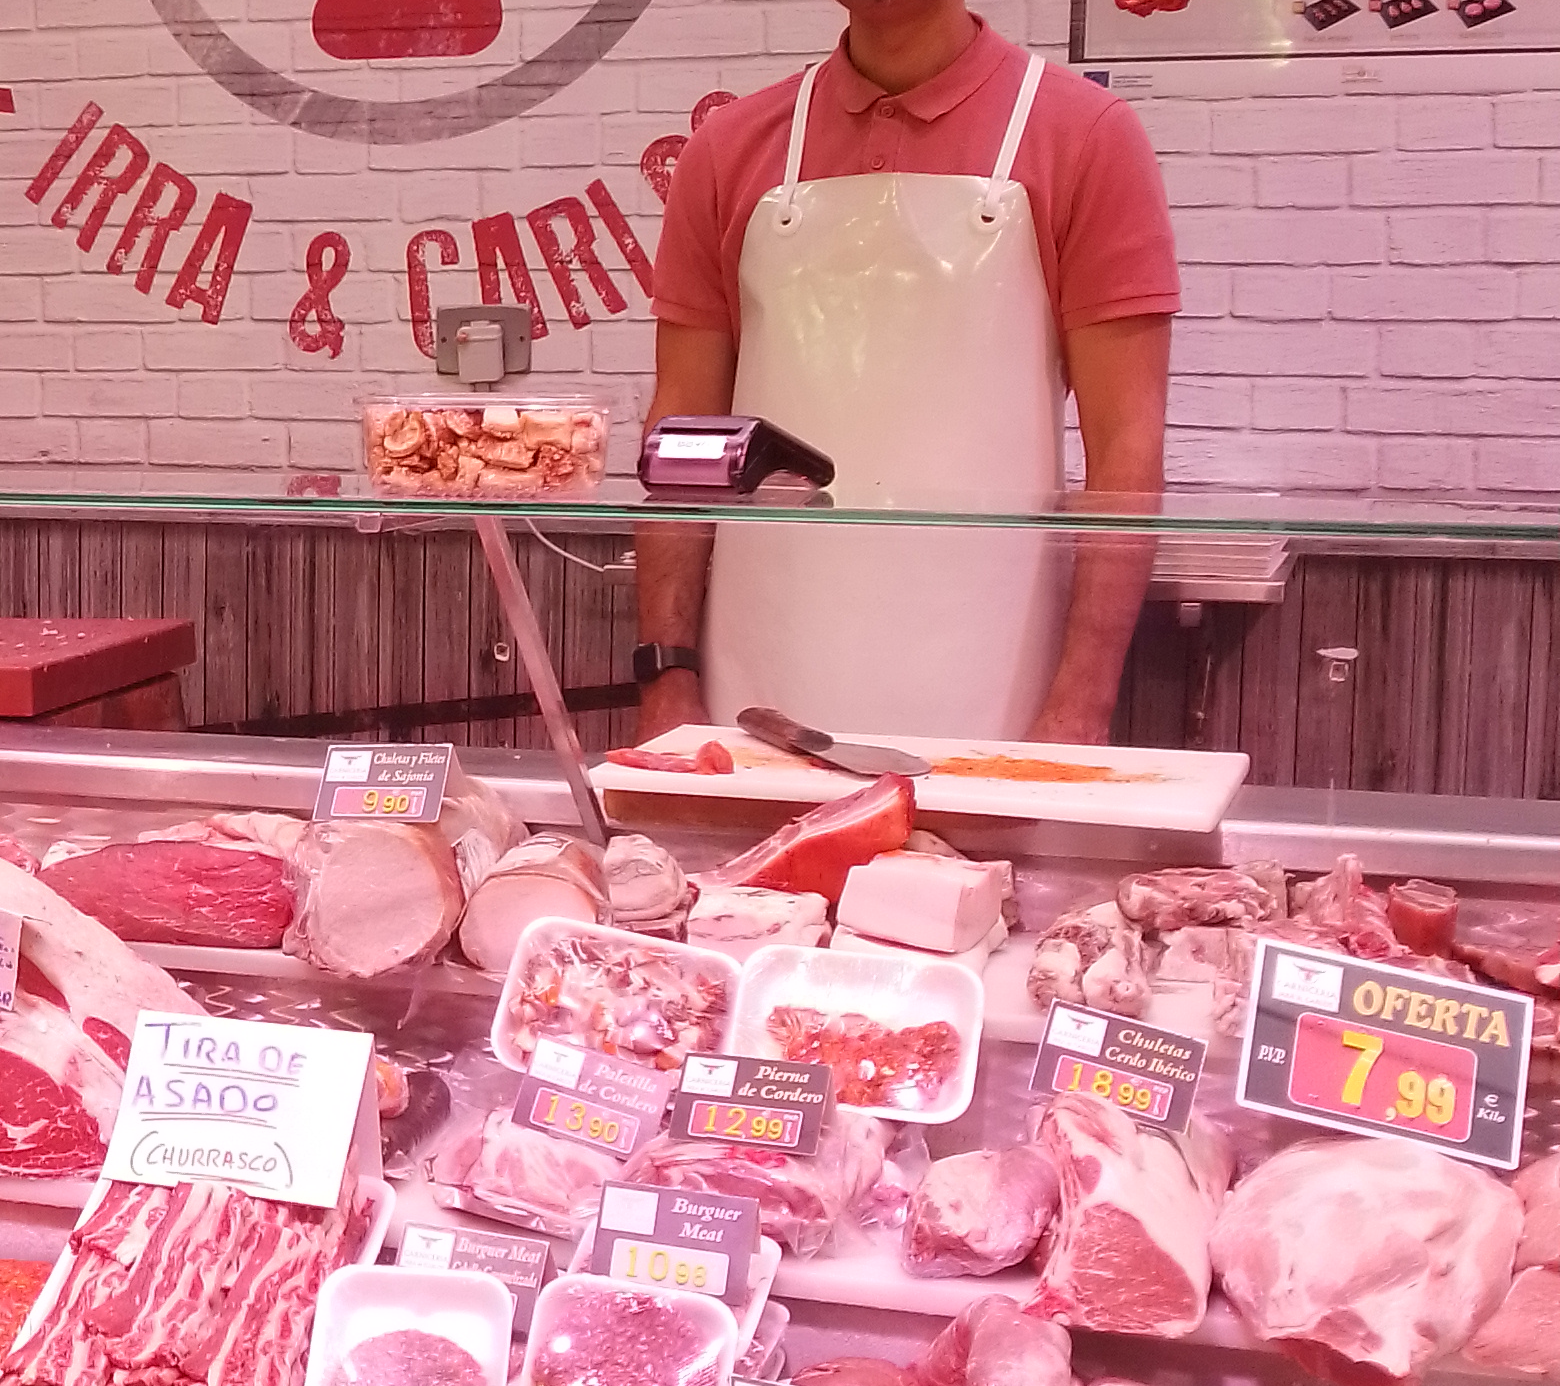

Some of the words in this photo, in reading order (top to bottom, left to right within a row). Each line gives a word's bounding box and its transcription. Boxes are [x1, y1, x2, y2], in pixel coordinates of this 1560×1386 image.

[24, 100, 253, 325] IRRA
[289, 231, 351, 360] &
[373, 752, 410, 765] Chuletas
[377, 769, 391, 782] de
[392, 769, 435, 785] Sajonia
[1352, 980, 1511, 1048] OFERTA
[144, 1022, 241, 1066] TIRA
[259, 1045, 308, 1076] DE
[1118, 1029, 1192, 1061] Chuletas
[753, 1065, 811, 1084] Pierna
[1105, 1046, 1147, 1069] Cerdo
[1147, 1058, 1196, 1083] Ibérico
[1341, 1030, 1457, 1127] 7,99
[594, 1064, 658, 1094] Paletilla
[737, 1082, 758, 1098] de
[760, 1085, 824, 1104] Cordero
[131, 1074, 279, 1114] ASADO
[577, 1079, 598, 1095] de
[599, 1086, 658, 1114] Cordero
[1483, 1093, 1500, 1108] €
[1476, 1107, 1506, 1124] Kilo
[670, 1197, 743, 1223] Burguer
[678, 1222, 725, 1243] Meat
[456, 1237, 509, 1260] Burguer
[507, 1245, 542, 1264] Meat
